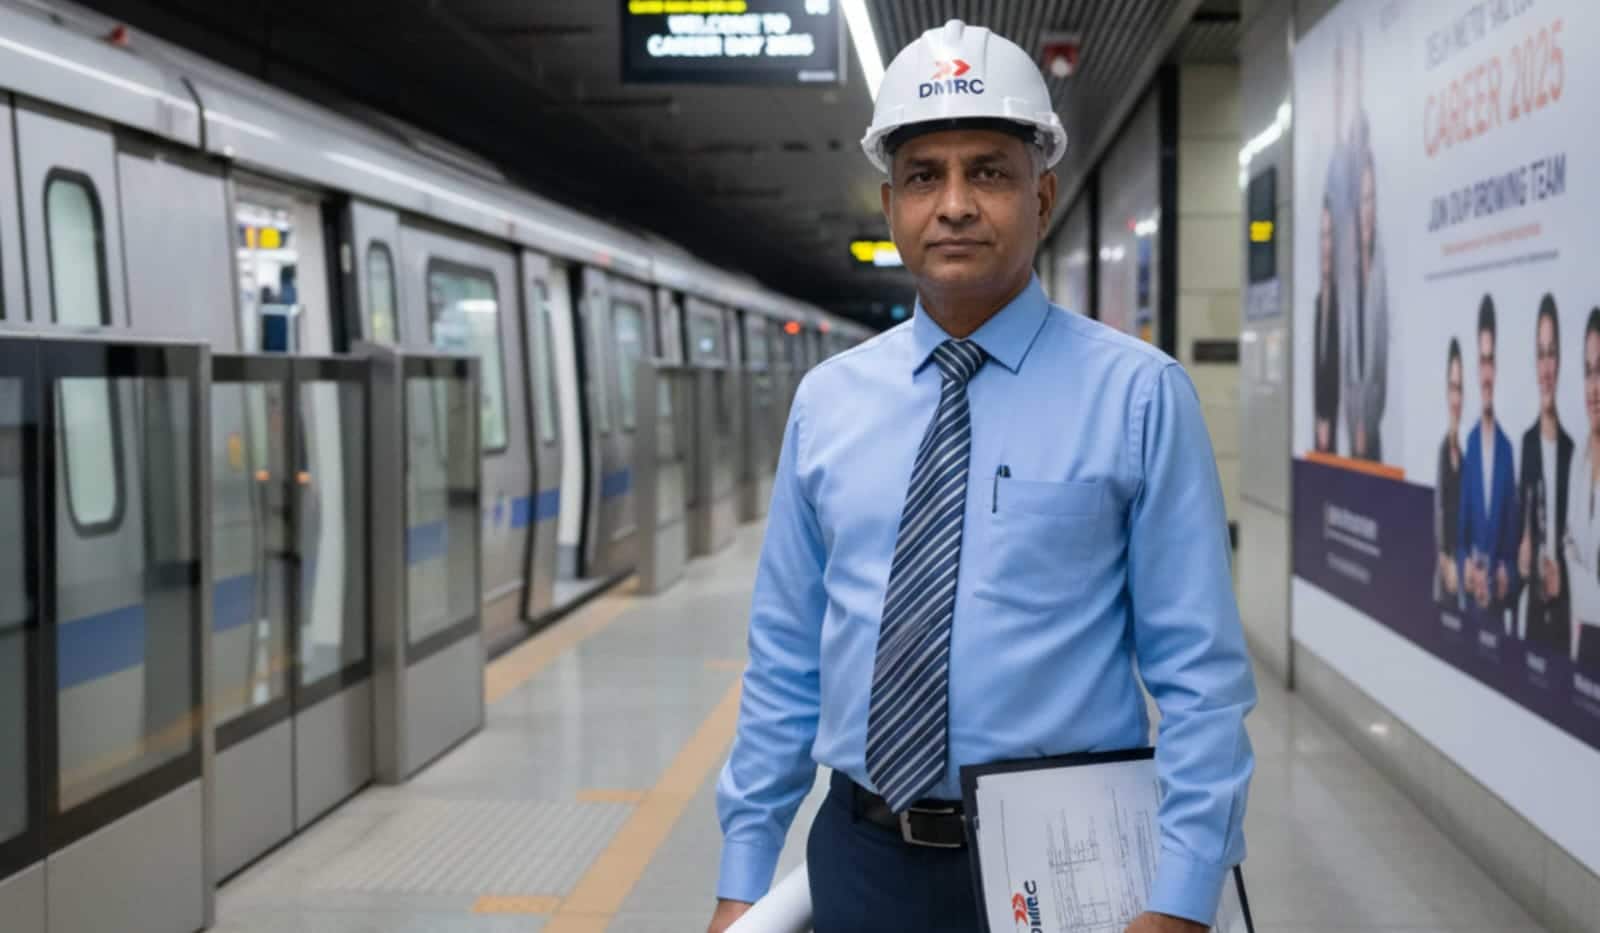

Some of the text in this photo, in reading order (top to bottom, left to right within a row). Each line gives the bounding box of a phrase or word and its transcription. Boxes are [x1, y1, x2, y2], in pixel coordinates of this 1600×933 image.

[919, 78, 985, 98] DMRC
[1424, 17, 1565, 158] CAREER 2025
